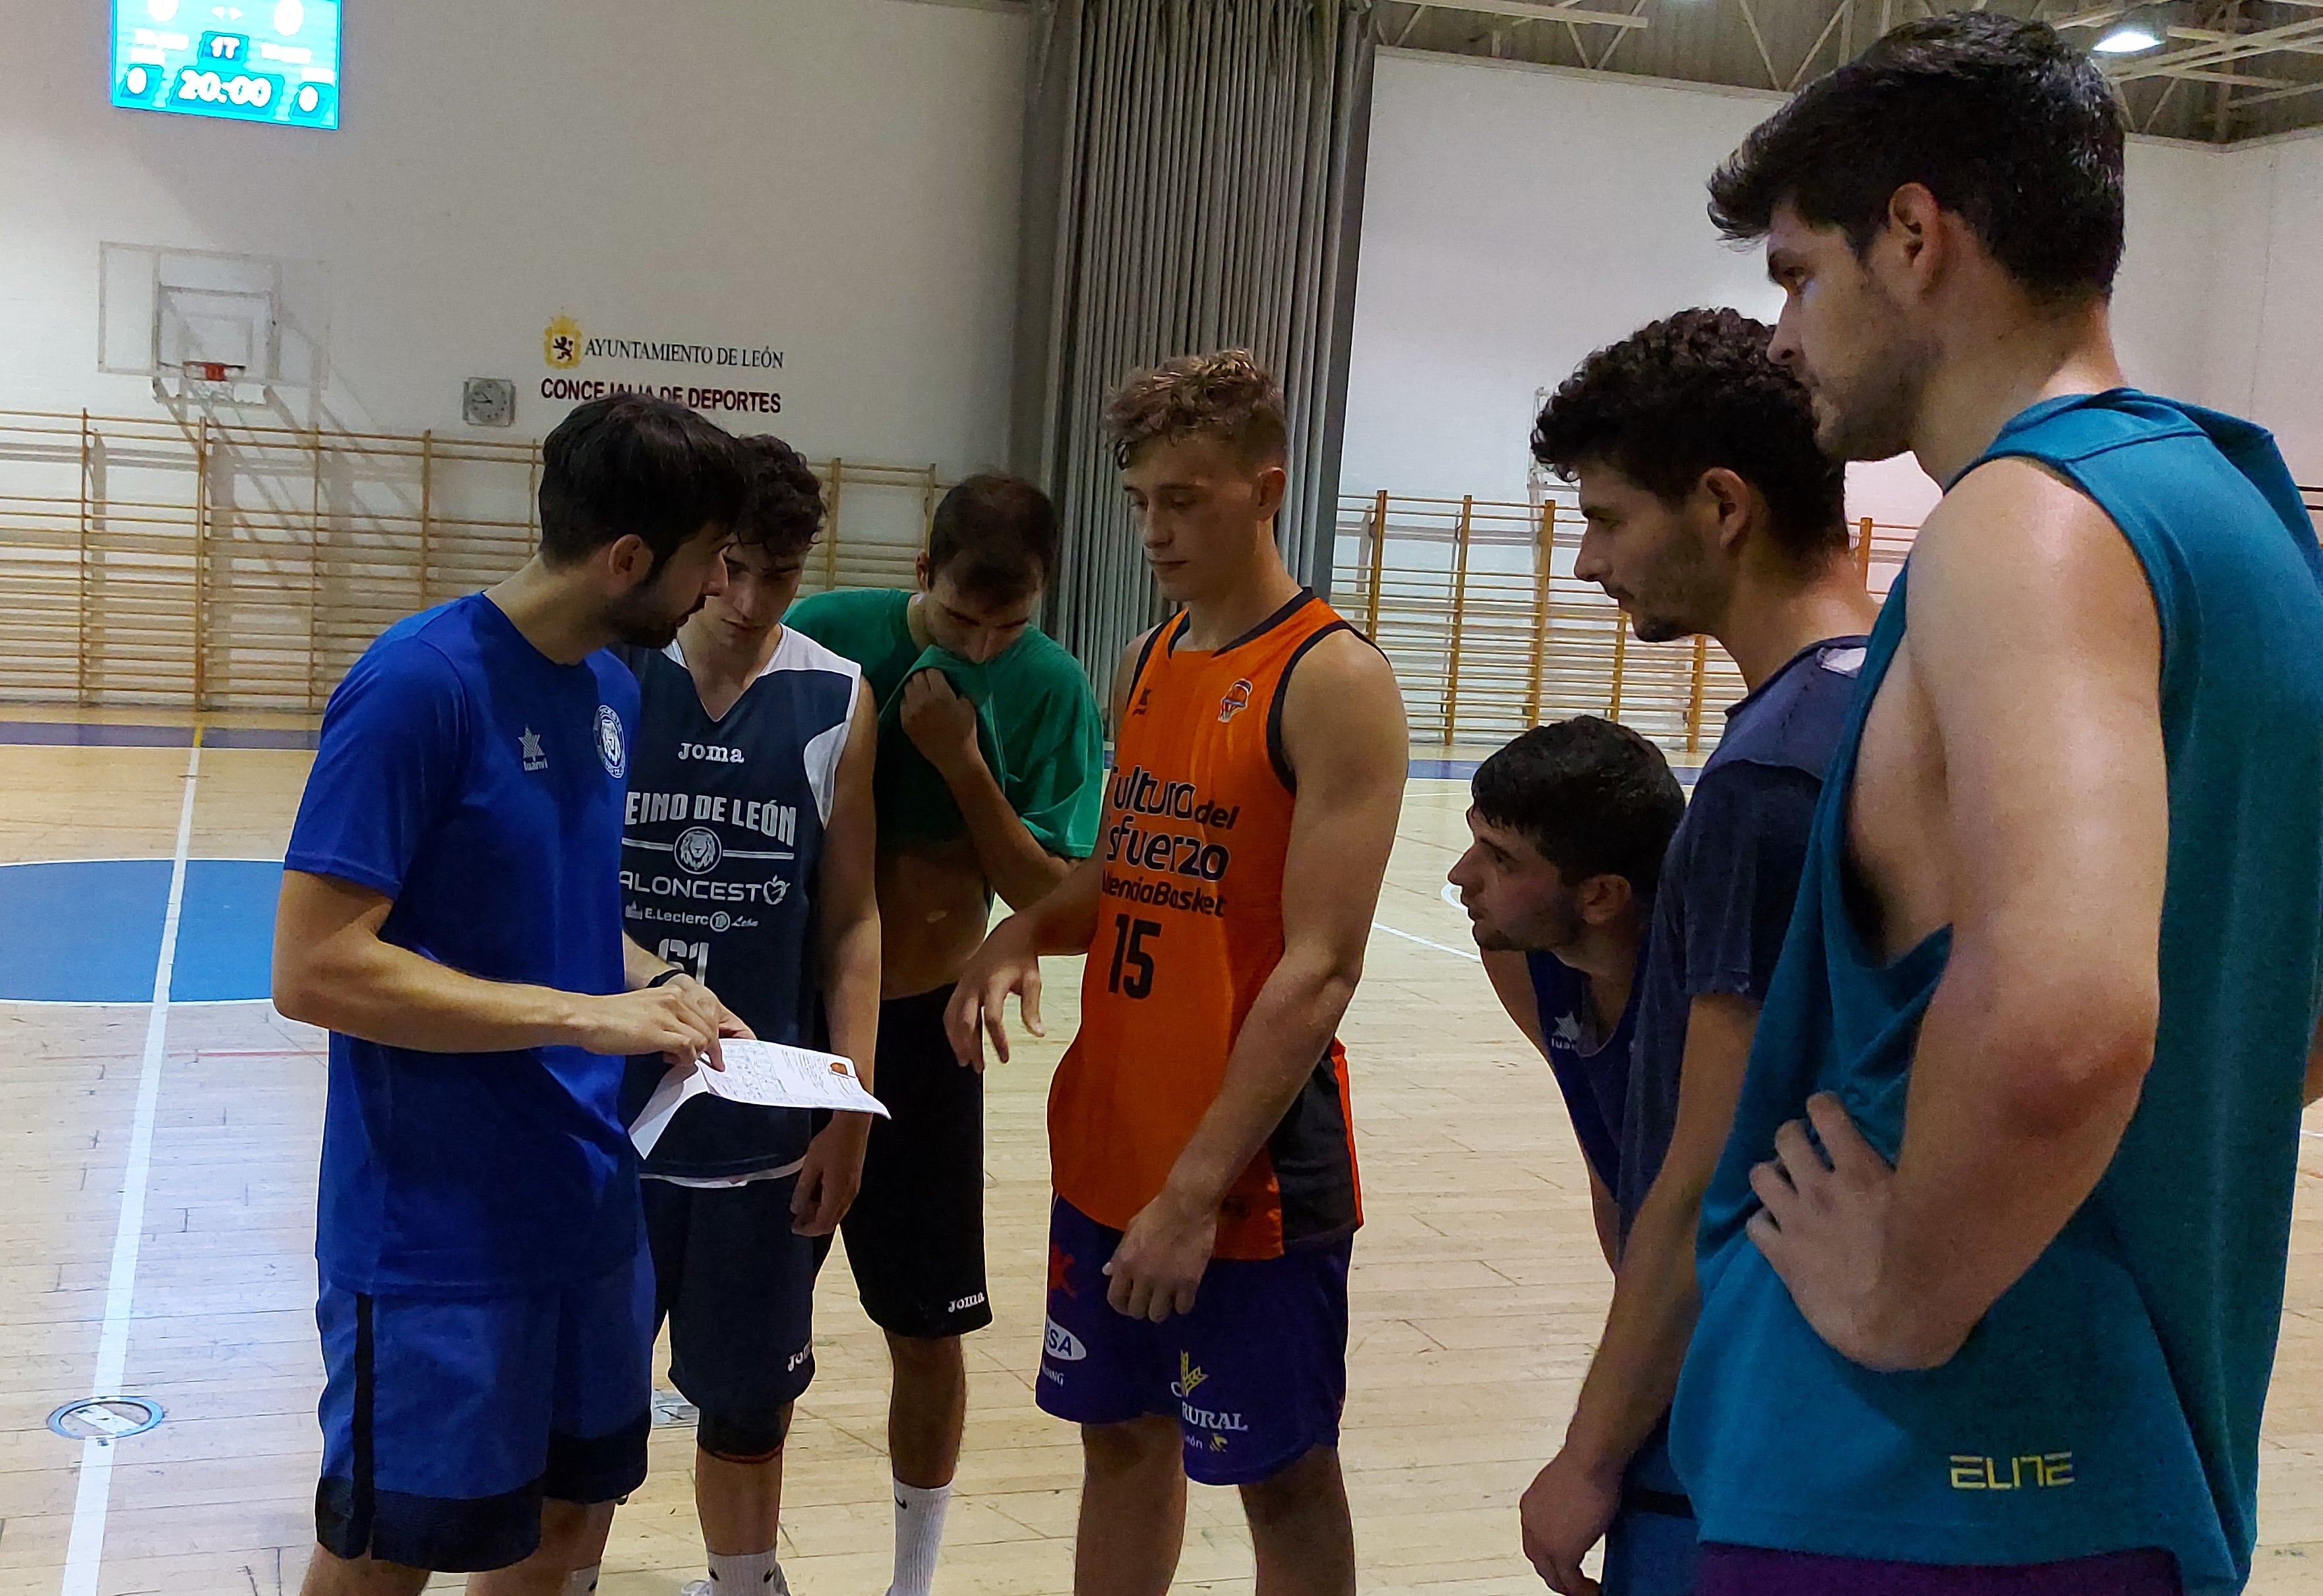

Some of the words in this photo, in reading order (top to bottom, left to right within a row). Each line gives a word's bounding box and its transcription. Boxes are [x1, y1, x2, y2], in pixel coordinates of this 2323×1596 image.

[127, 67, 147, 94] 0
[177, 69, 272, 107] 20:00
[298, 85, 318, 112] 0
[584, 338, 713, 364] AYUNTAMIENTO
[717, 347, 737, 366] DE
[742, 346, 783, 369] LEÓN
[688, 388, 781, 413] DEPORTES
[1113, 765, 1197, 820] ultura
[1194, 800, 1240, 830] del
[624, 792, 688, 825] EINO
[694, 795, 727, 823] DE
[732, 800, 797, 847] LEÓN
[1106, 815, 1231, 882] sfuerzo
[644, 907, 709, 925] E.Leclerc
[1108, 913, 1162, 1000] 15
[1045, 1322, 1071, 1357] SA
[1182, 1400, 1249, 1433] RURAL
[1949, 1451, 2075, 1490] ELITE
